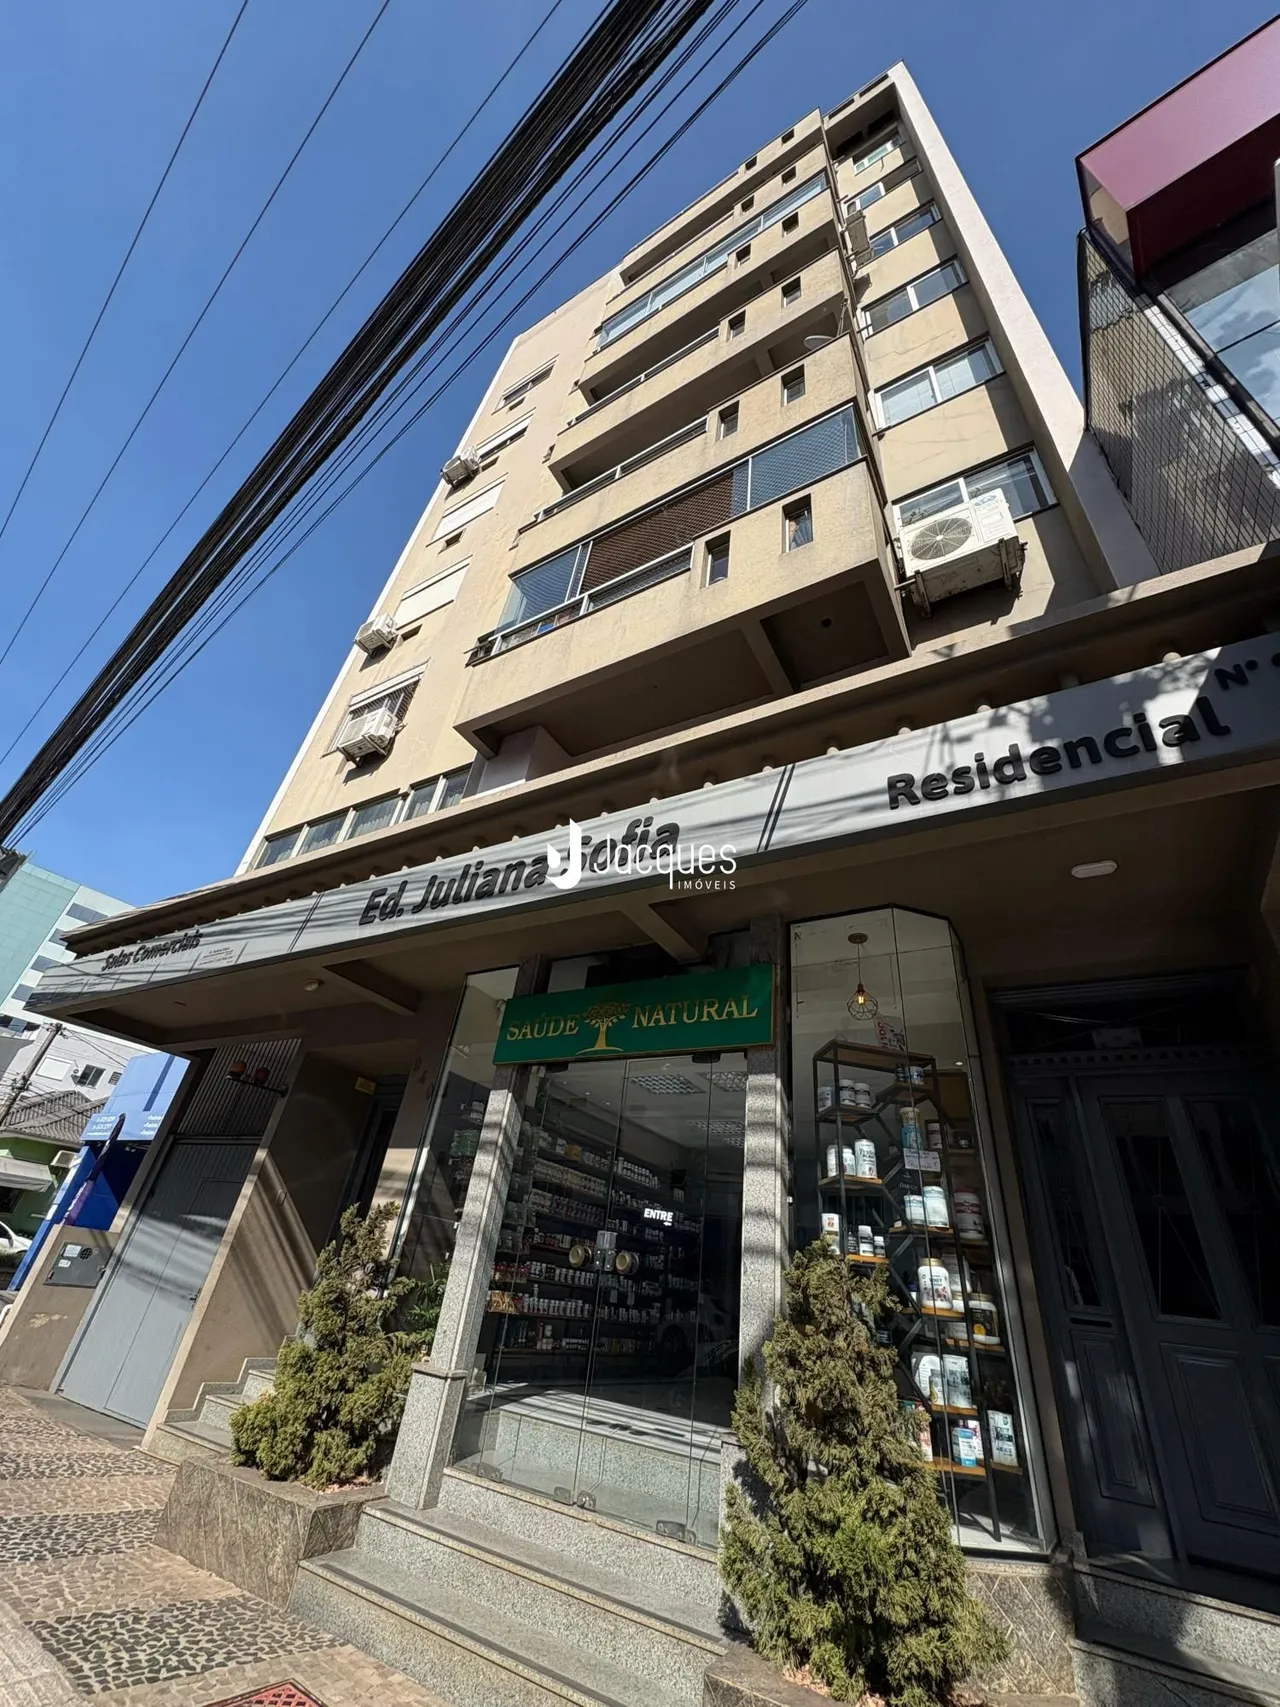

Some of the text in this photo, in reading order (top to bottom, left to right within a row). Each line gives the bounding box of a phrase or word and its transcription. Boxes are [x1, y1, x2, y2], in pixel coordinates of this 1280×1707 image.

[886, 696, 1232, 811] Residencial
[358, 880, 404, 926] Ed.
[412, 853, 549, 914] Juliana
[101, 949, 132, 972] Salas
[506, 994, 759, 1041] SAÚDE NATURAL
[643, 1208, 674, 1222] ENTRE
